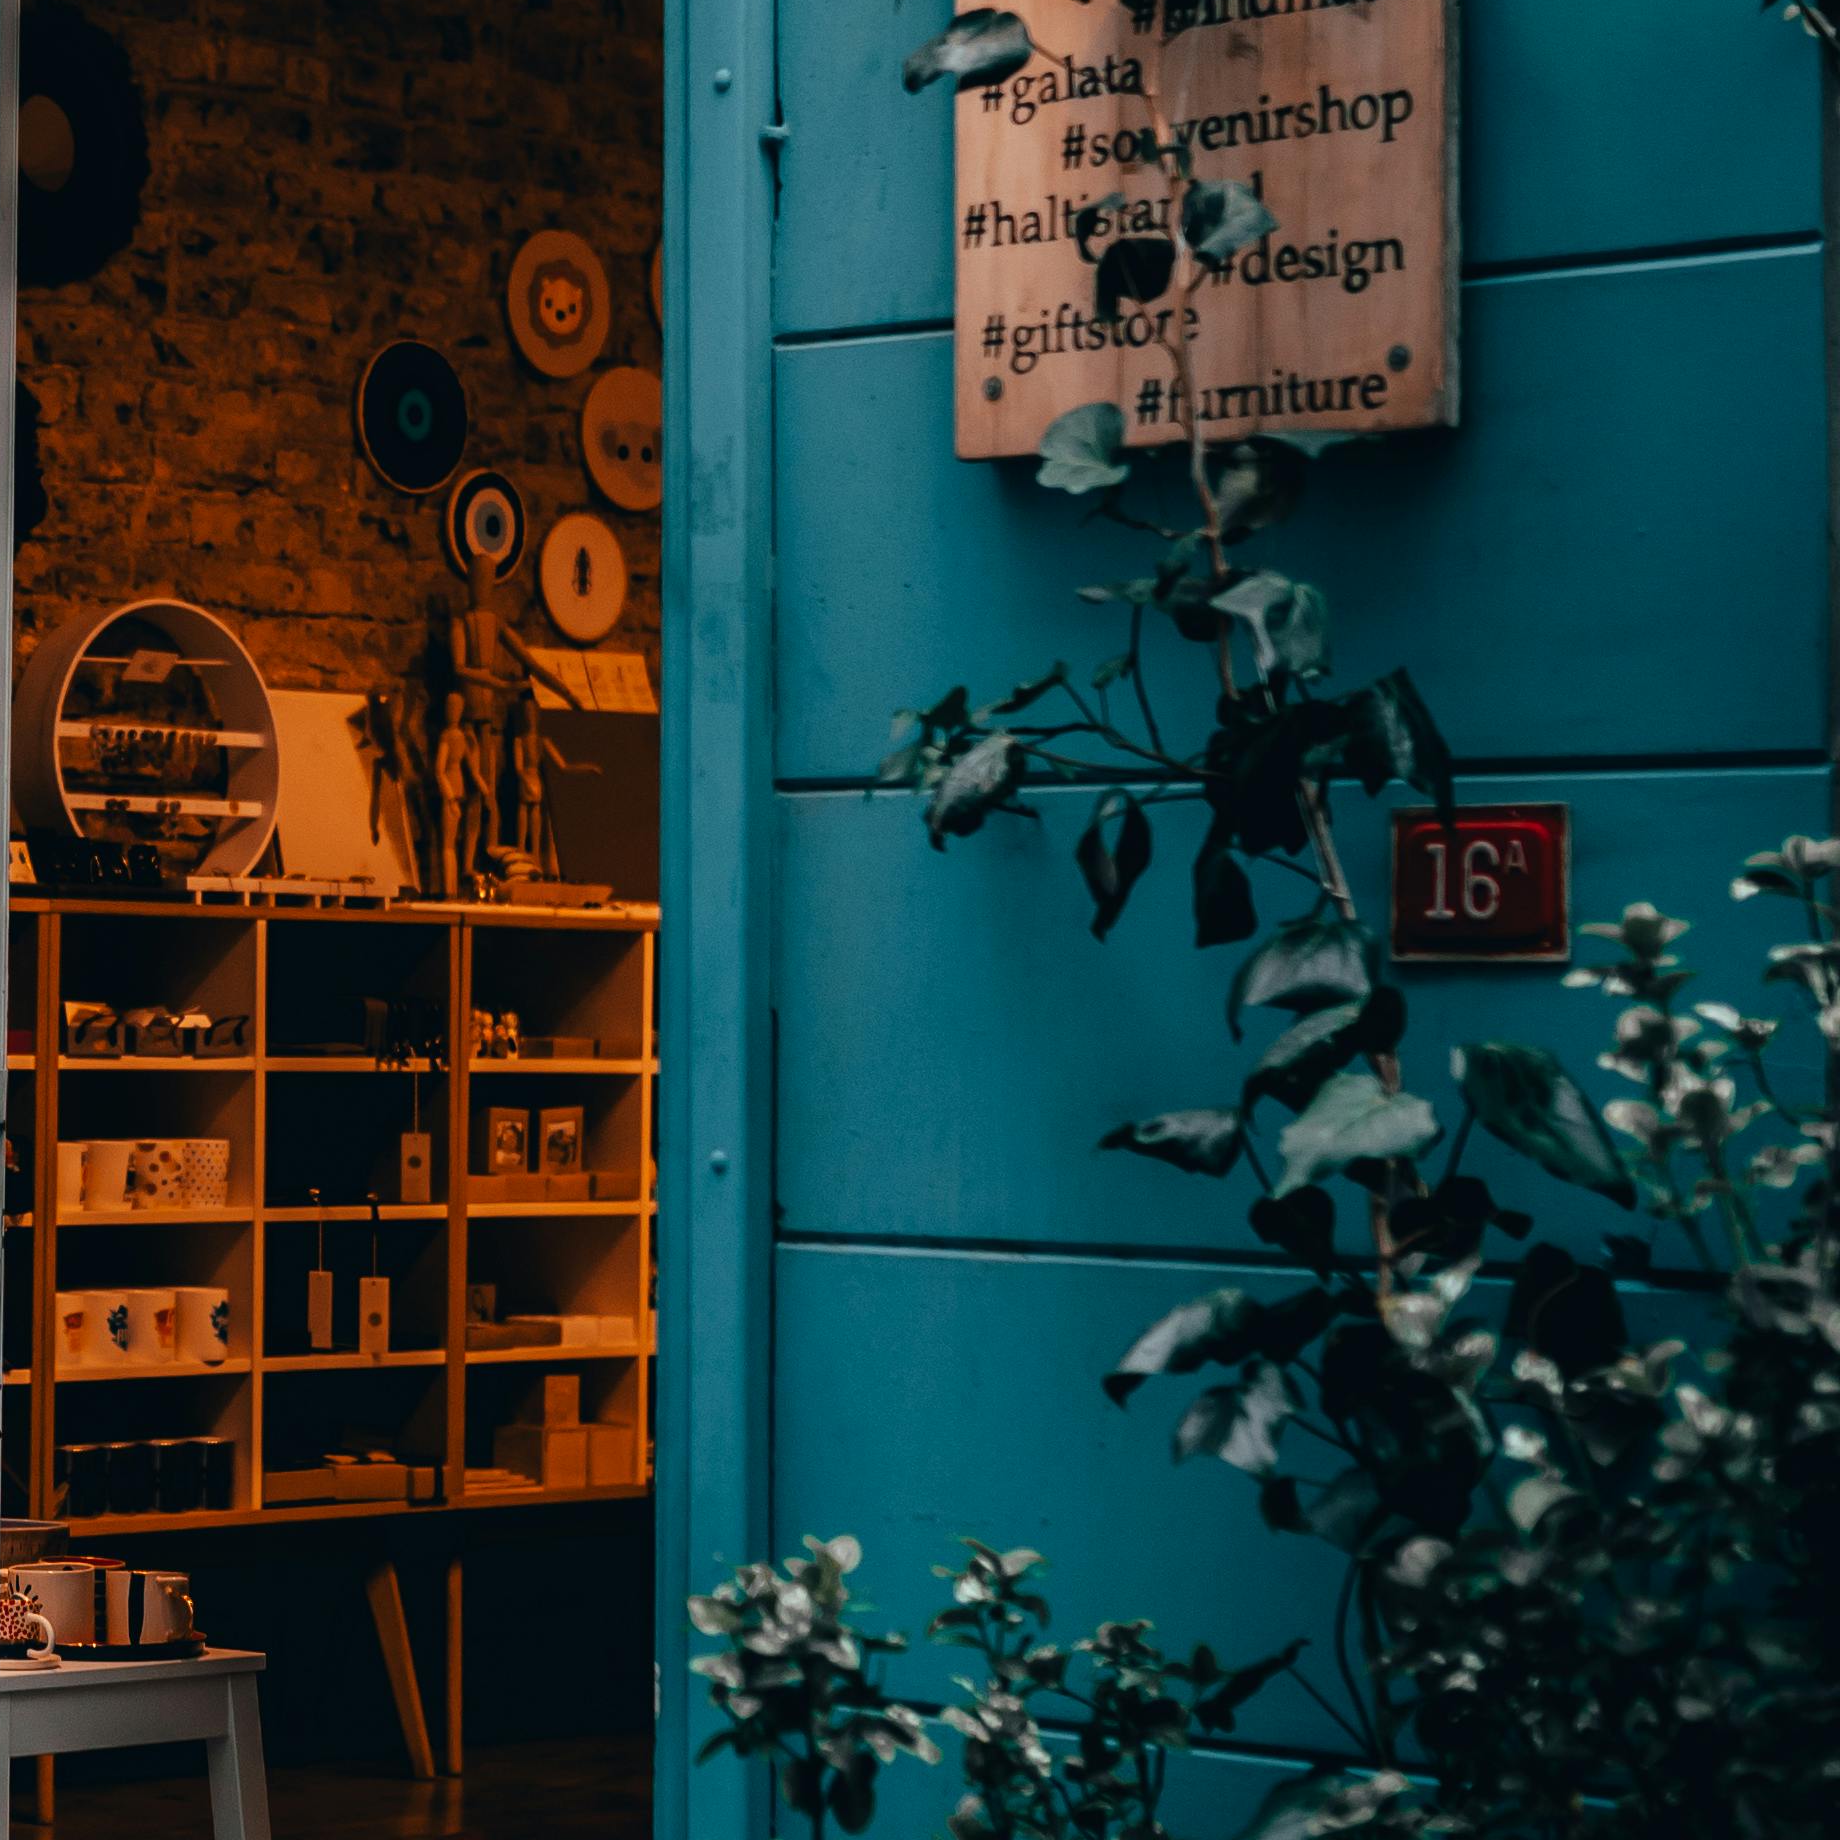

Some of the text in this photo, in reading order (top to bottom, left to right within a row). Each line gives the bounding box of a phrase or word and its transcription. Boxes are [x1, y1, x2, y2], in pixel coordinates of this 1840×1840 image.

[982, 53, 1143, 126] #galata
[1064, 86, 1414, 170] #sovenirshop
[1208, 230, 1405, 294] #design
